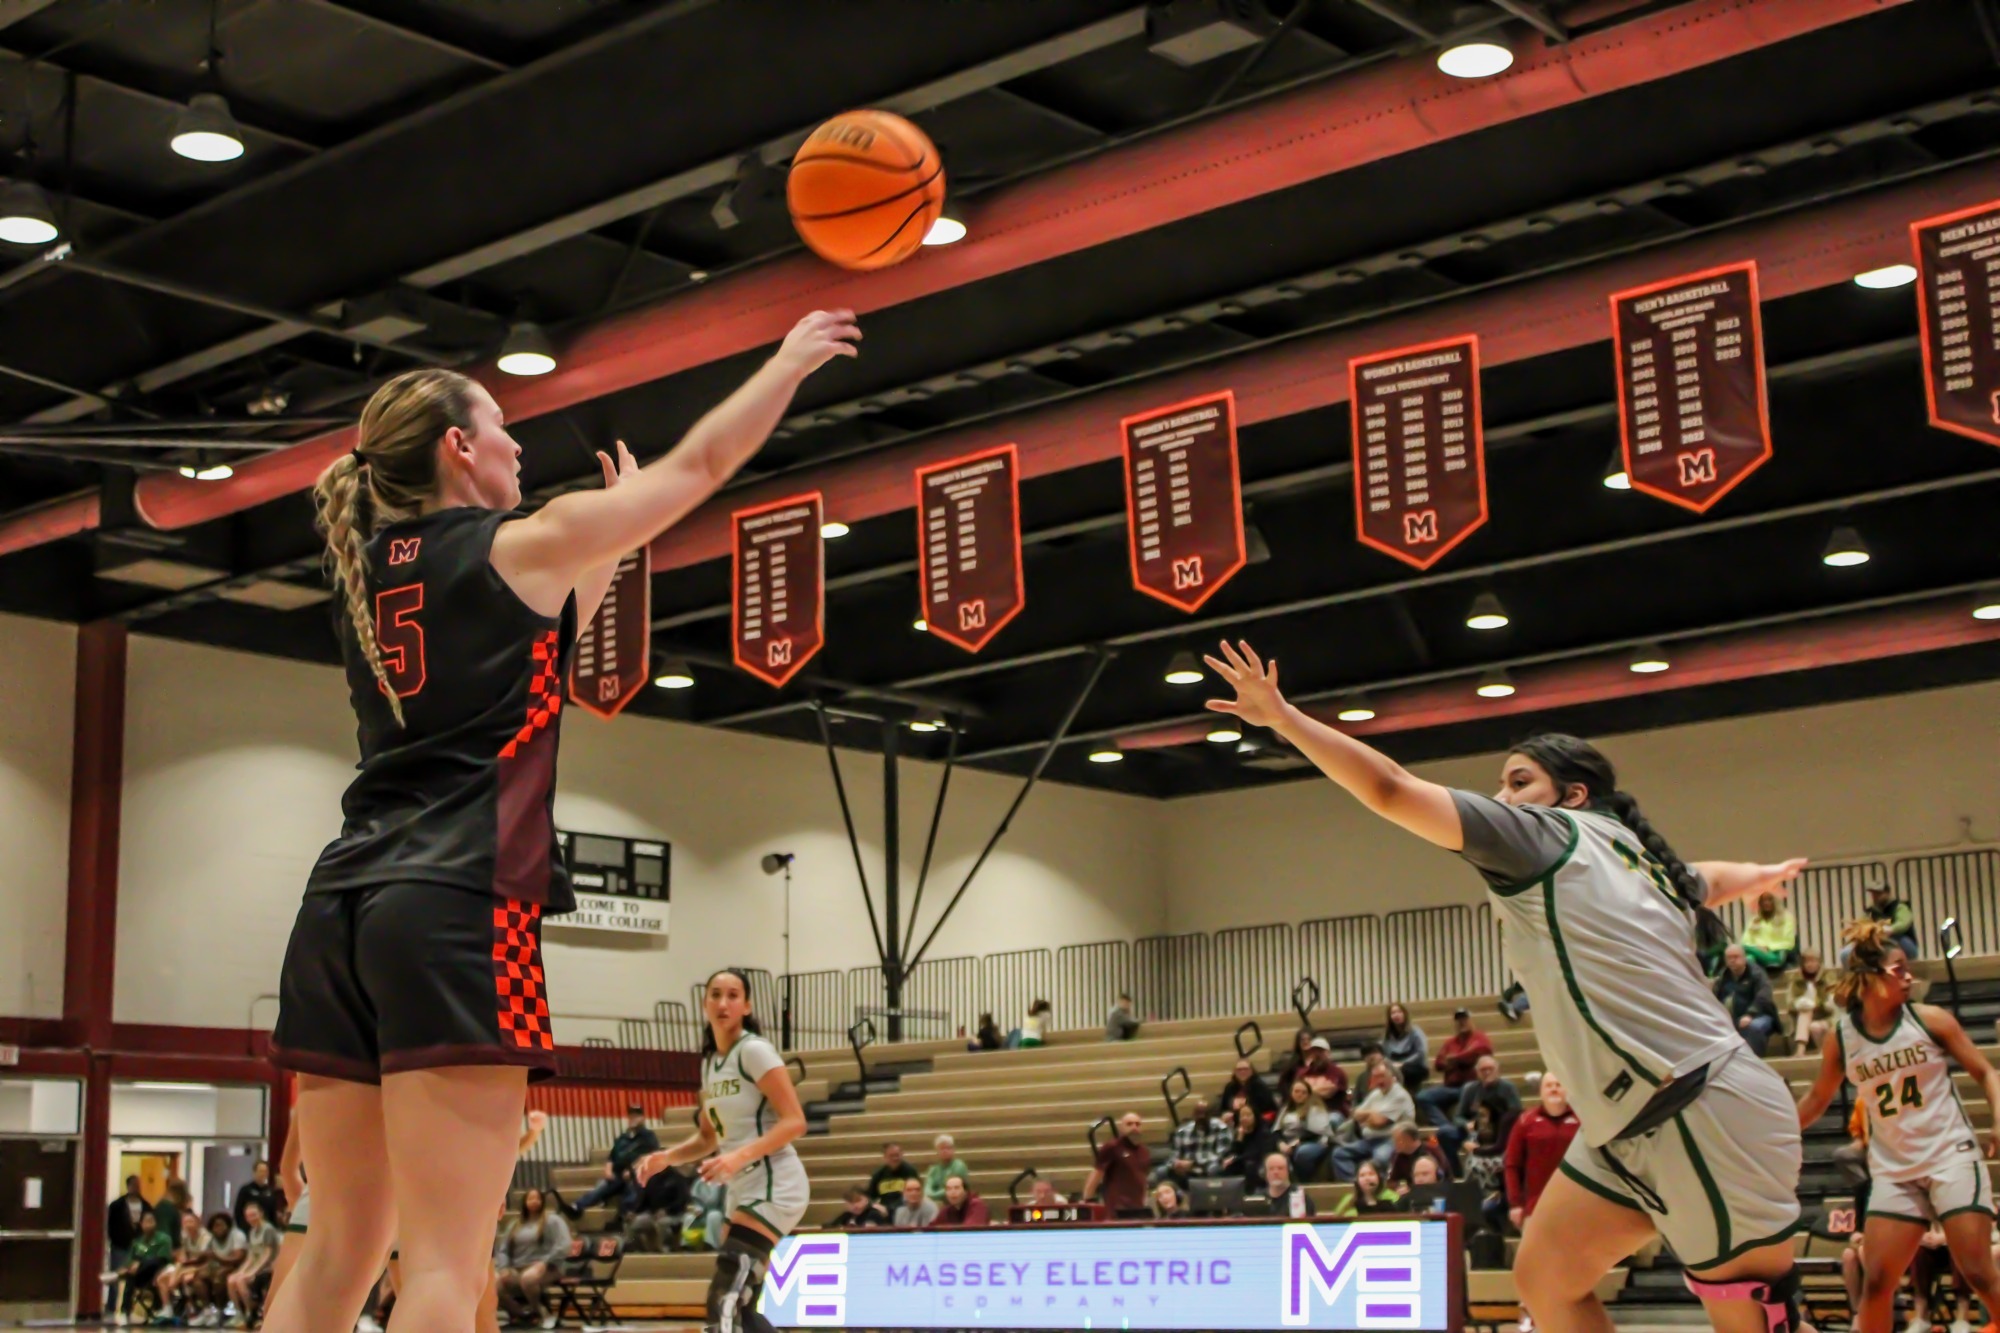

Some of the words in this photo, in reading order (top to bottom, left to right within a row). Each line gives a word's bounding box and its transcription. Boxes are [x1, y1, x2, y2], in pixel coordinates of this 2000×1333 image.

[1667, 281, 1730, 305] BASKETBALL
[1716, 333, 1741, 347] 2024
[1943, 331, 1969, 345] 2007
[1405, 352, 1462, 372] BASKETBALL
[1638, 425, 1661, 439] 2007
[1677, 448, 1717, 488] M
[1403, 509, 1438, 544] M
[389, 538, 421, 565] M
[1173, 556, 1203, 589] M
[958, 600, 986, 631] M
[376, 582, 427, 699] 5
[768, 637, 791, 667] M
[580, 898, 616, 913] COME
[623, 902, 640, 915] TO
[609, 916, 664, 931] COLLEGE
[1875, 1075, 1923, 1118] 24
[1829, 1210, 1856, 1233] M
[885, 1262, 1031, 1288] MASSEY
[1046, 1259, 1232, 1287] ELECTRIC
[944, 1294, 1160, 1309] COMPANY
